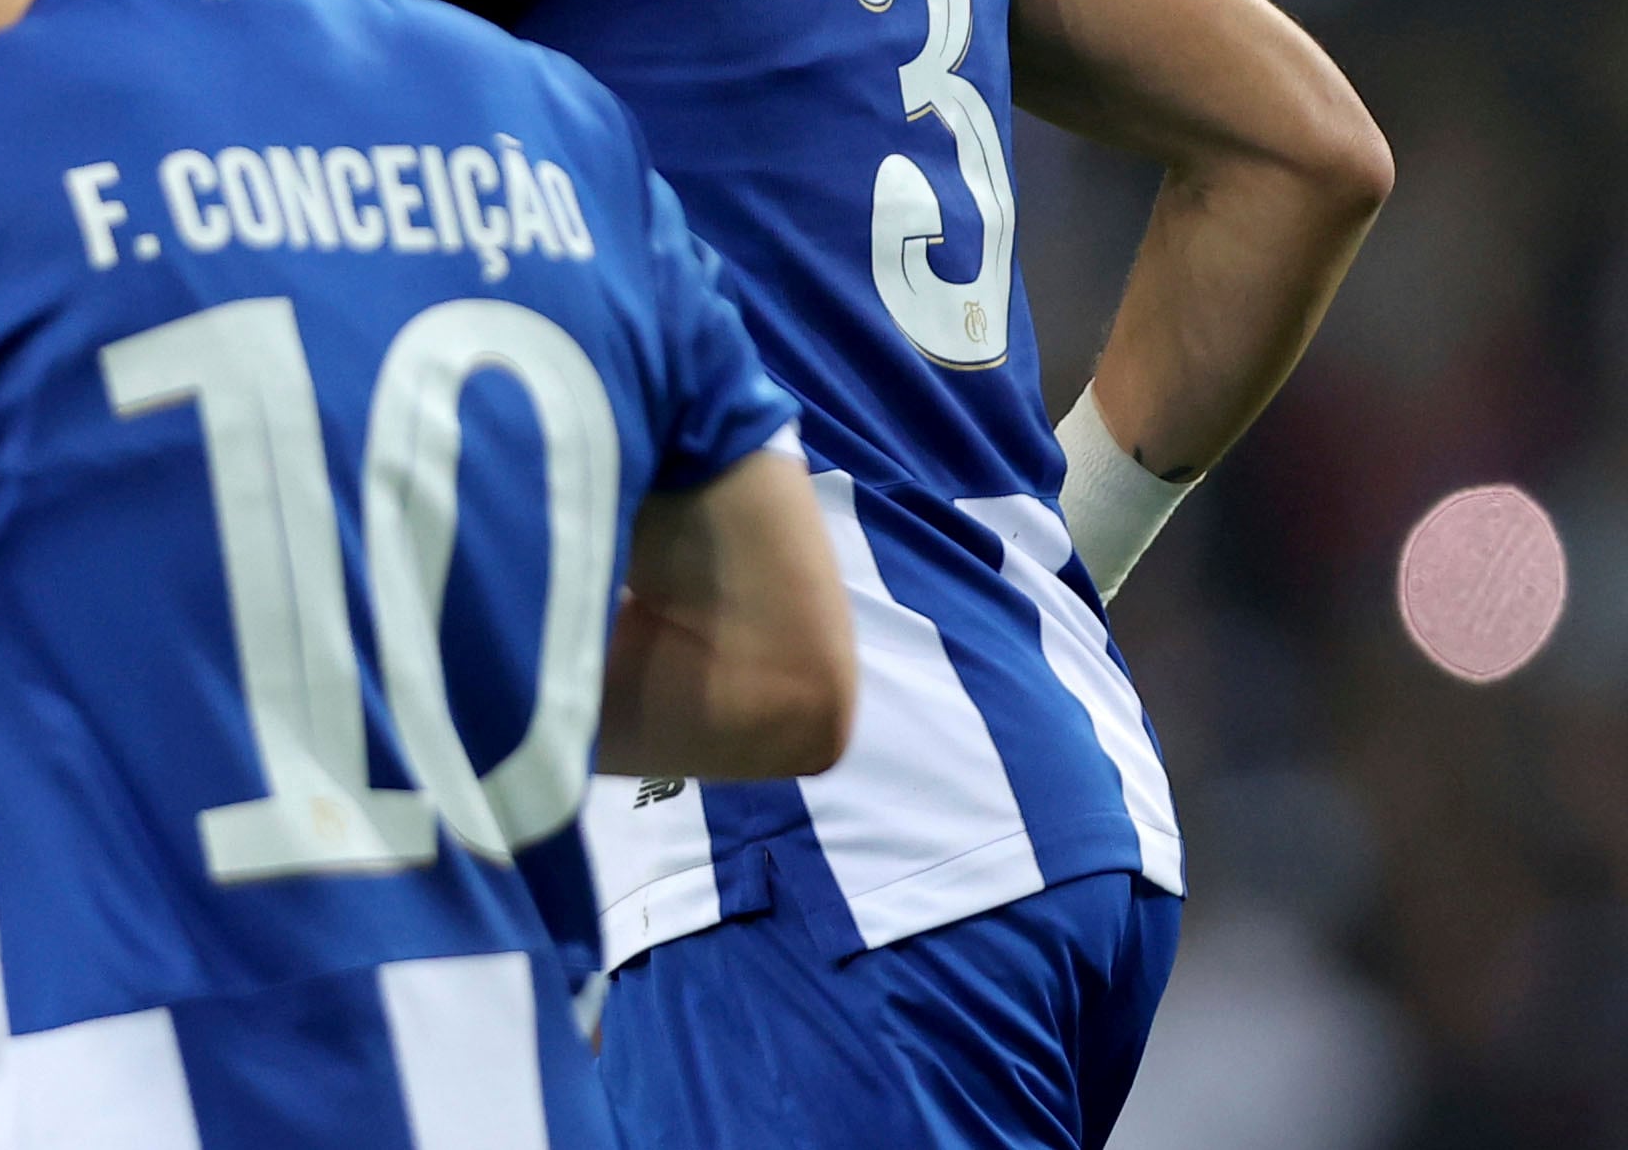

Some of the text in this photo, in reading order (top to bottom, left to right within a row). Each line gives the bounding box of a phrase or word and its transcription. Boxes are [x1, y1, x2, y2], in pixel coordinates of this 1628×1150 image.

[64, 132, 596, 283] F. CONCEIÇÃO
[99, 296, 621, 884] 10
